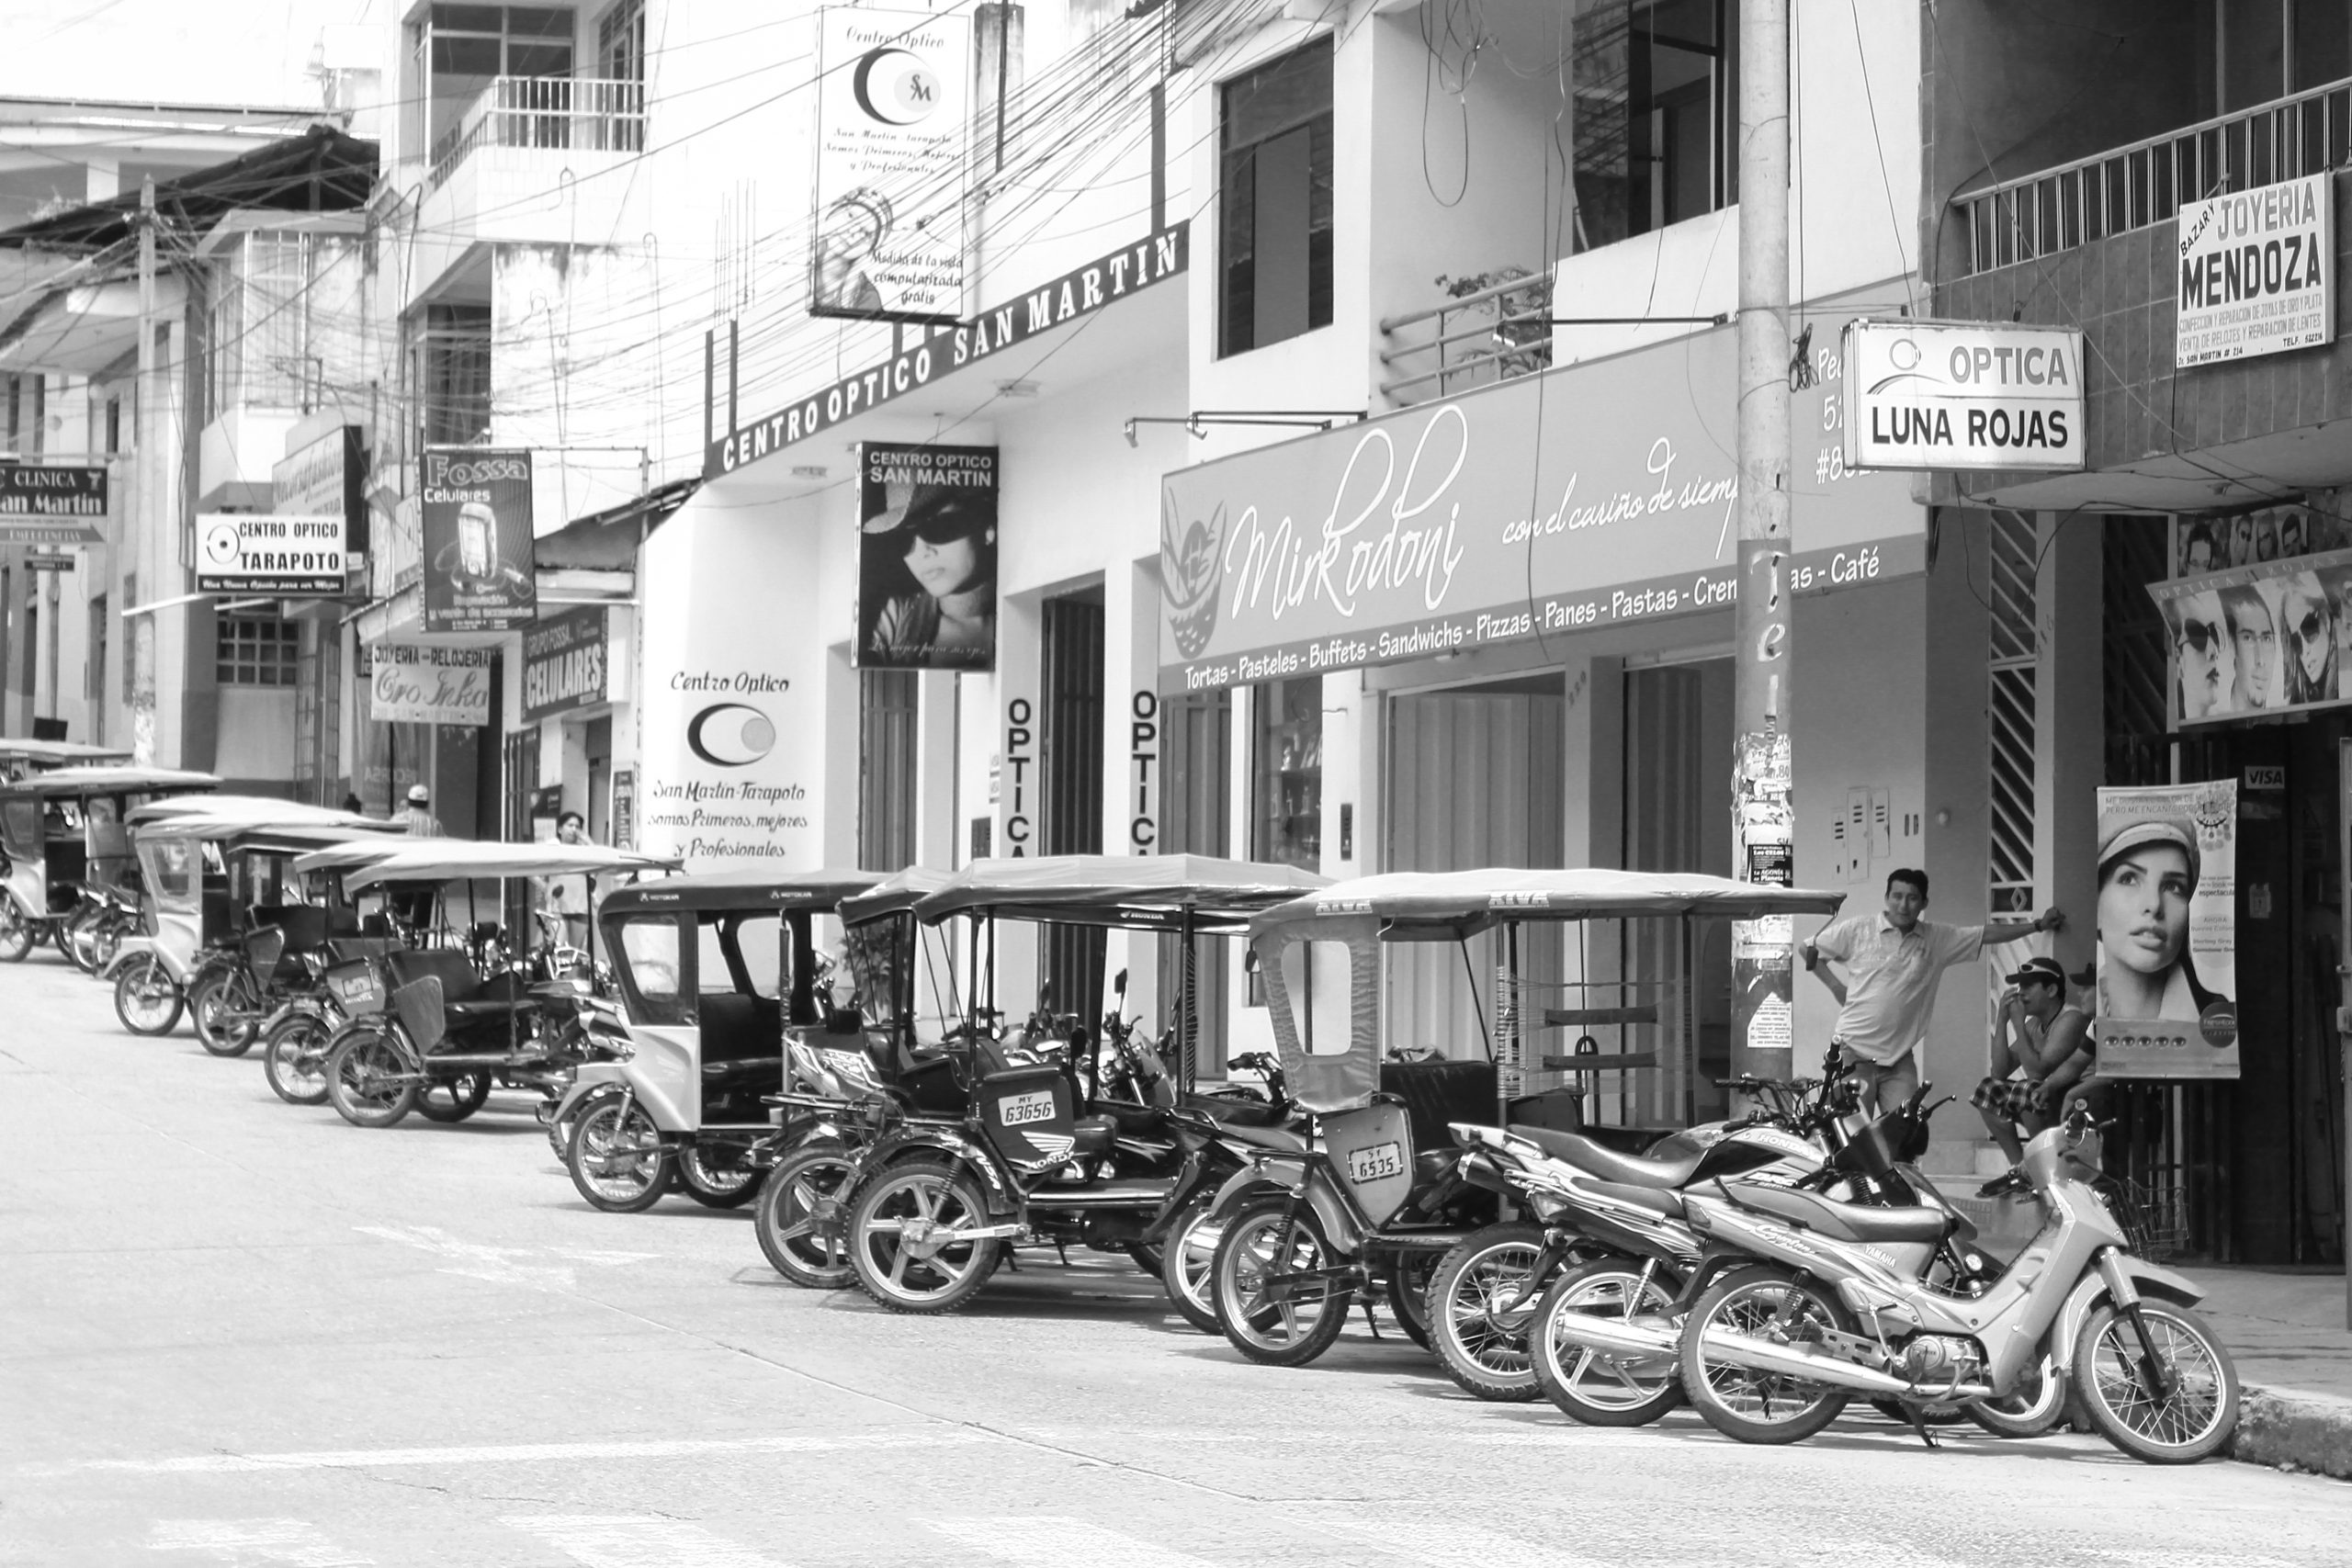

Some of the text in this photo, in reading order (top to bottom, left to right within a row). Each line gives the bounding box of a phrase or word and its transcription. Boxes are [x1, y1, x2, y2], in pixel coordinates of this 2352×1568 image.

[846, 25, 944, 51] Centro Optico
[2218, 181, 2316, 242] JOYERIA
[2181, 231, 2322, 312] MENDOZA
[2178, 334, 2199, 353] VENTA
[2211, 327, 2241, 347] RELOJES
[2248, 320, 2288, 340] REPARACION
[2296, 312, 2321, 332] LENTES
[723, 231, 1178, 472] CENTRO OPTICO SAN MARTIN
[2187, 353, 2199, 365] SAN
[2199, 348, 2222, 362] MARTIN
[1949, 345, 2068, 387] OPTICA
[1871, 405, 1954, 446] LUNA
[1968, 407, 2069, 449] ROJAS
[426, 454, 528, 488] Fossa
[869, 450, 991, 469] CENTRO OPTICO
[15, 469, 75, 488] CLINICA
[870, 466, 991, 487] SAN MARTIN
[424, 487, 491, 503] Celulares
[1501, 517, 1544, 545] con
[1544, 472, 1577, 534] el
[239, 522, 338, 538] CENTRO OPTICO
[240, 552, 339, 570] TARAPOTO
[1185, 663, 1228, 691] Tortas
[1238, 652, 1297, 682] Pasteles
[1309, 639, 1367, 670] Buffets
[1378, 620, 1463, 659] Sandwichs
[1476, 613, 1531, 642] Pizzas
[1544, 601, 1597, 630] Panes
[1611, 588, 1678, 619] Pastas
[1830, 546, 1880, 584] Café
[375, 645, 490, 670] JOYERIA RELOJERIA
[526, 641, 602, 710] CELULARES
[671, 671, 790, 695] Centro Optico
[653, 779, 684, 799] San
[2249, 770, 2283, 785] VISA
[647, 813, 689, 828] somos
[756, 812, 808, 833] mejores
[689, 838, 786, 859] Profesionales
[1005, 1101, 1052, 1123] 63656
[1864, 1244, 1896, 1268] YAMAHA
